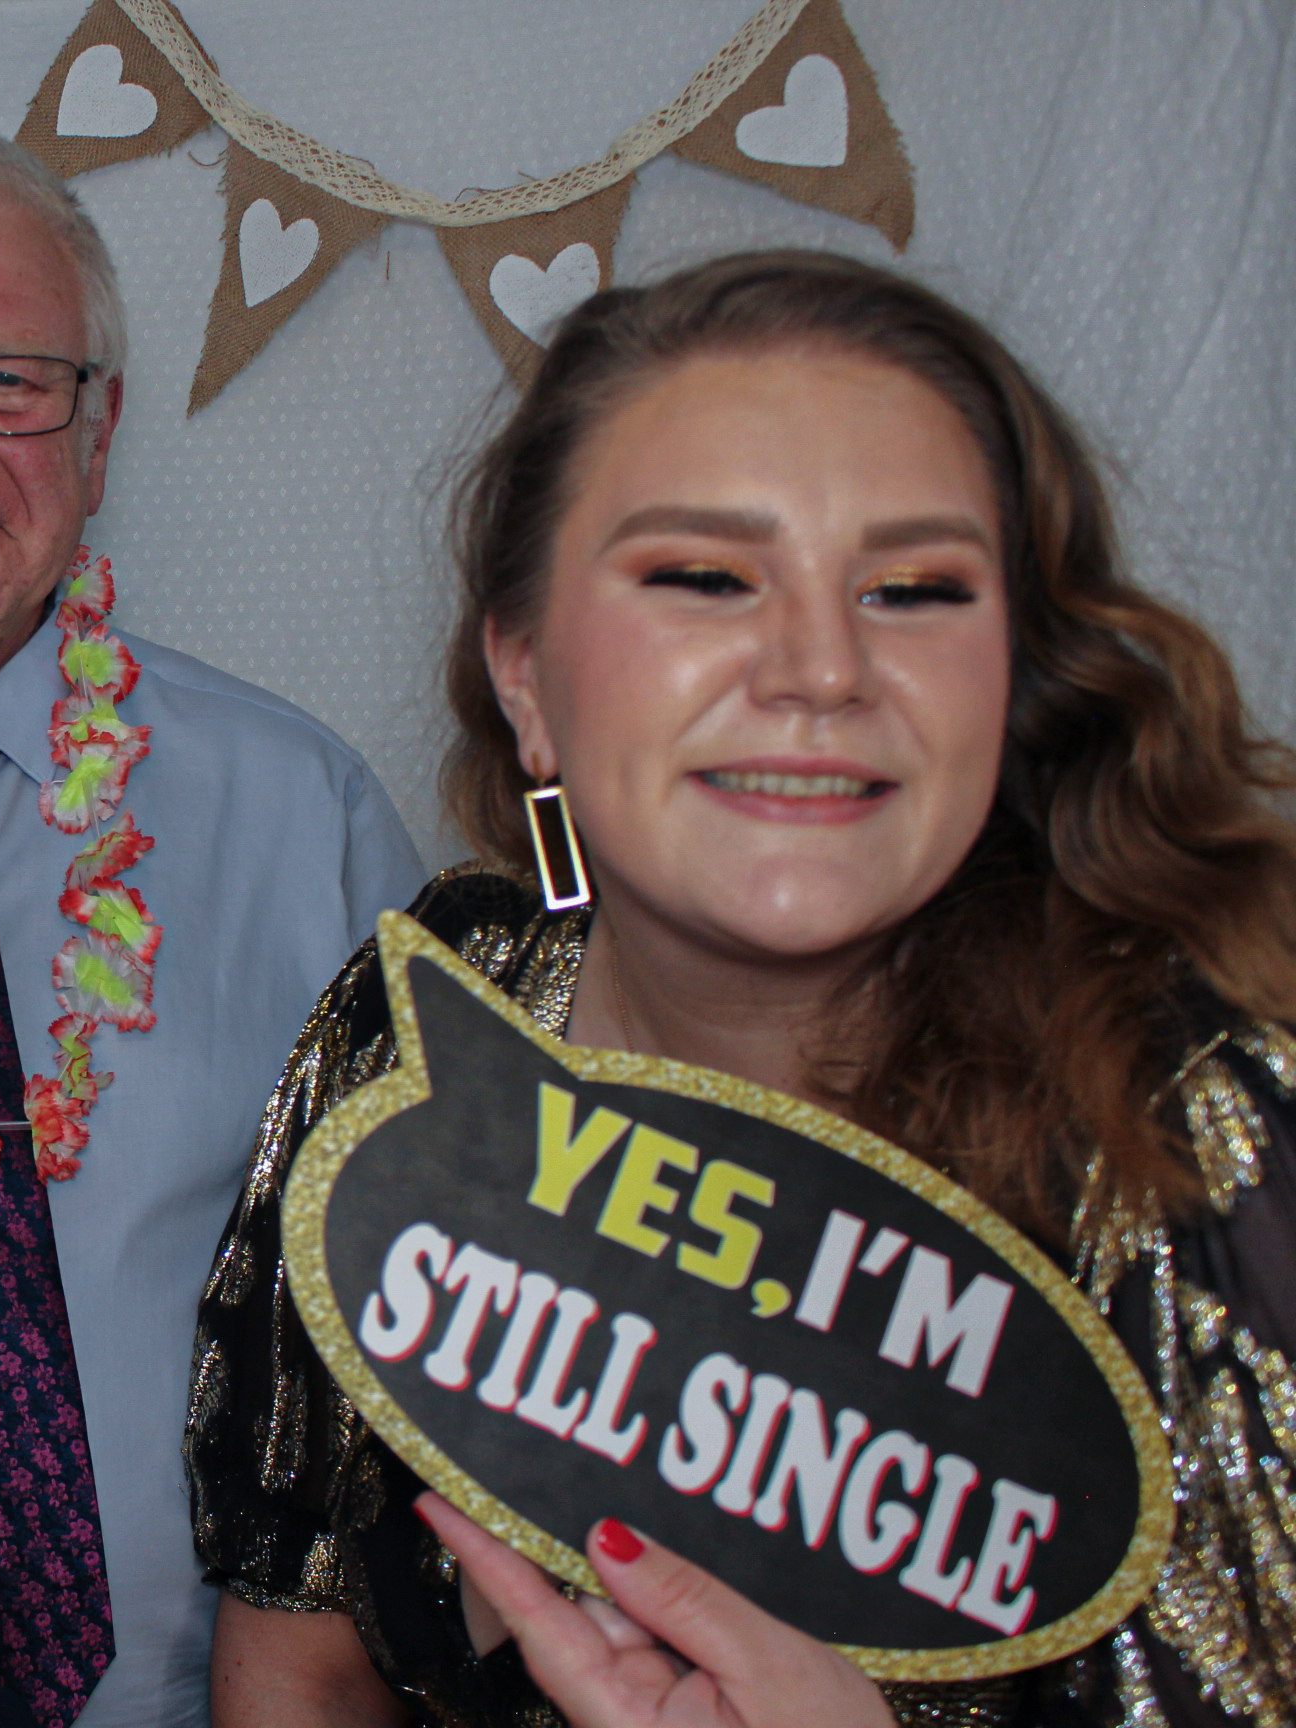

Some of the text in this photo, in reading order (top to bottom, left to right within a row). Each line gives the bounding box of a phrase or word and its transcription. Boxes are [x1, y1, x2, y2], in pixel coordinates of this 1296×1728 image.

[527, 1081, 1014, 1398] YES, I'M
[359, 1221, 1058, 1637] STILL SINGLE
